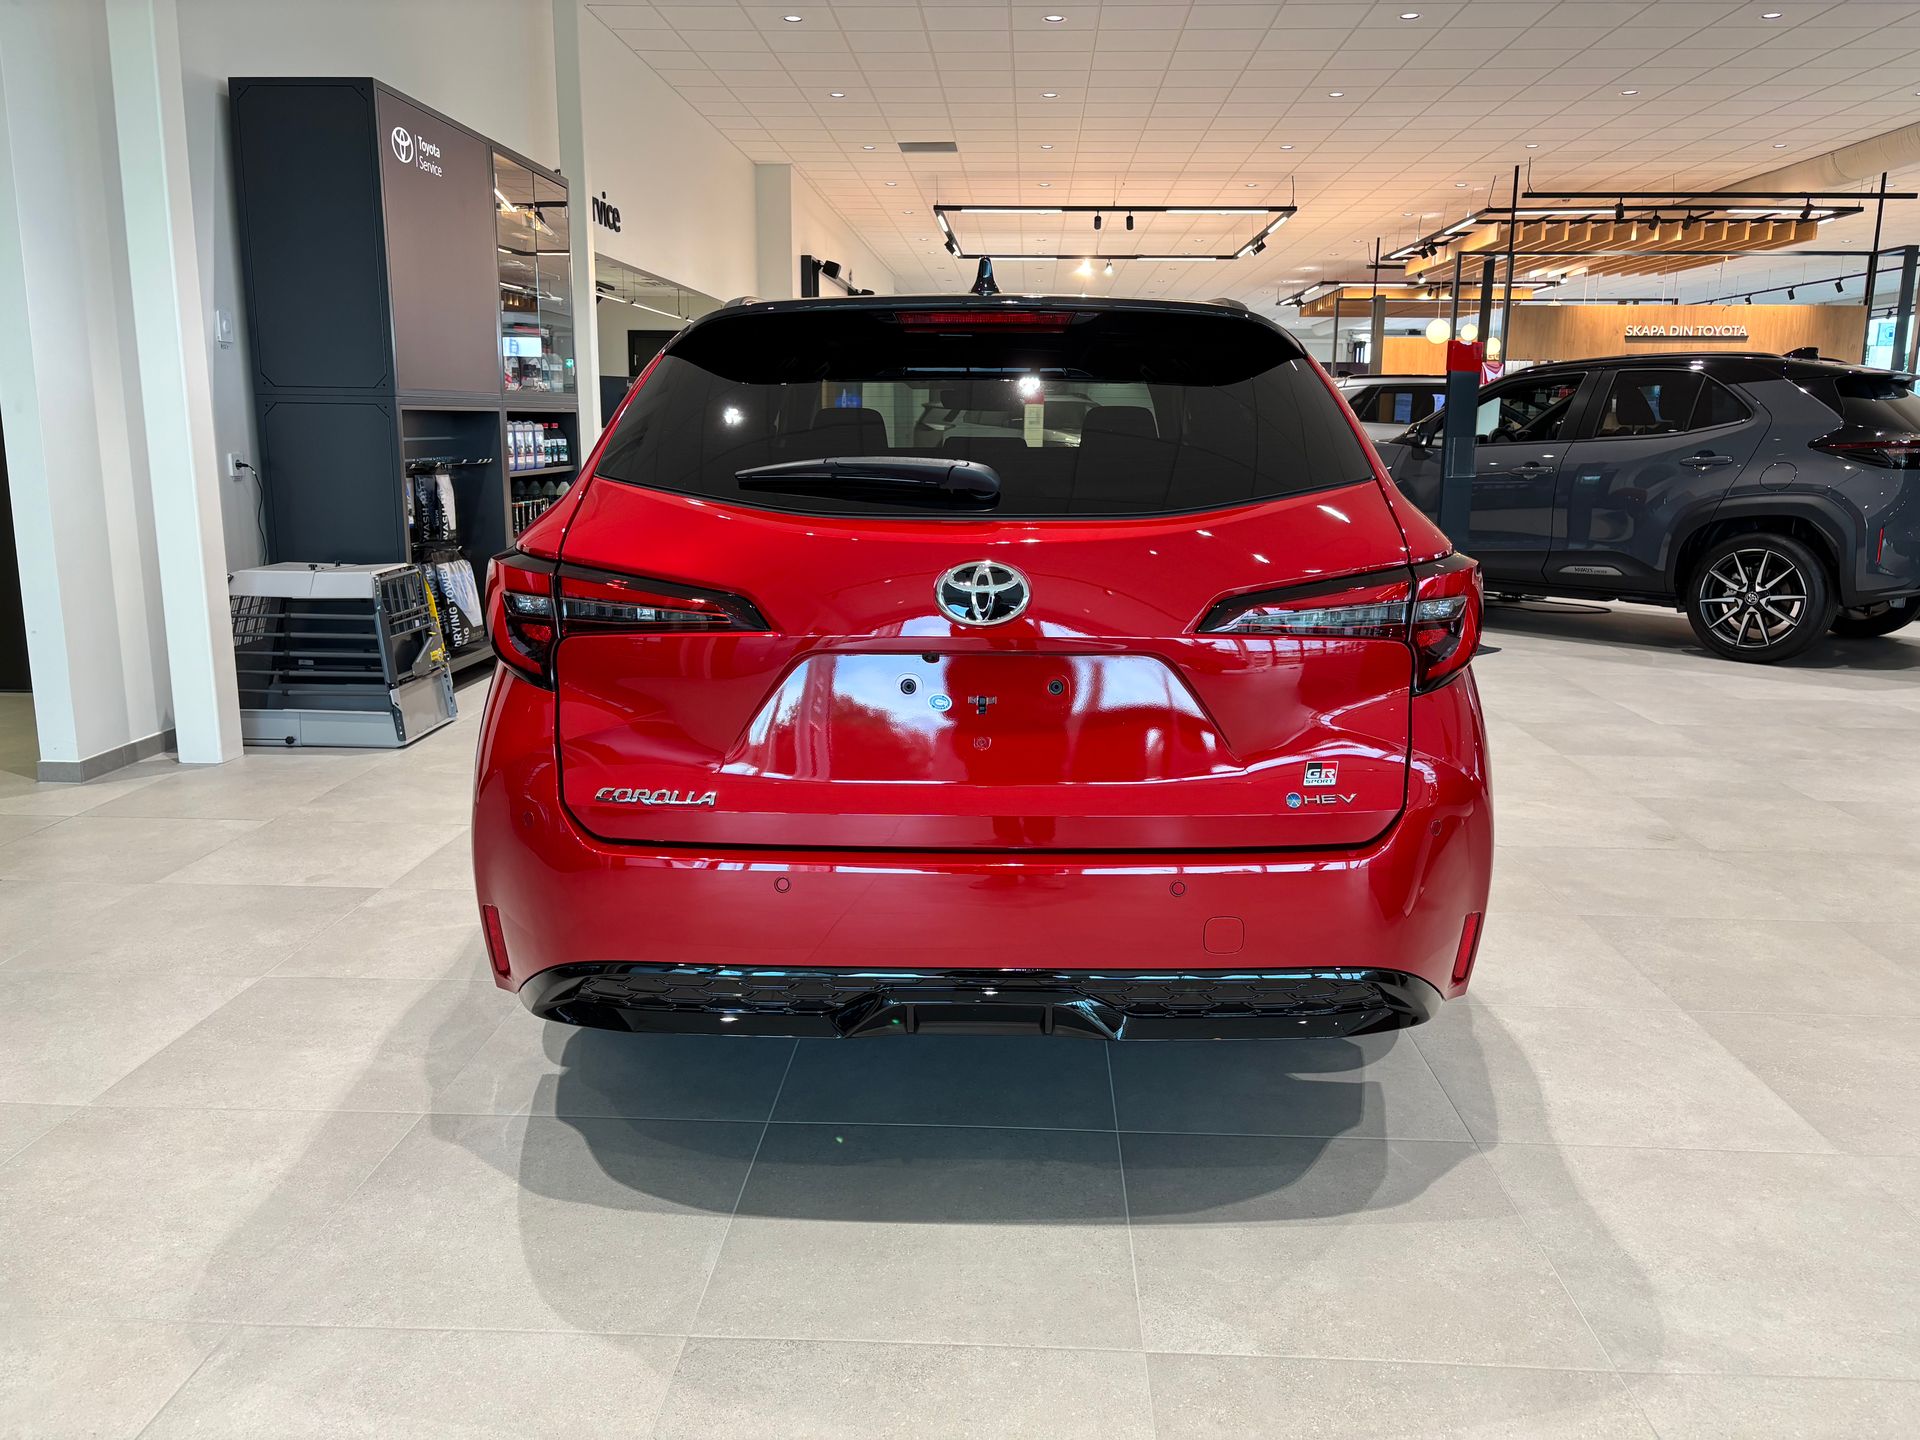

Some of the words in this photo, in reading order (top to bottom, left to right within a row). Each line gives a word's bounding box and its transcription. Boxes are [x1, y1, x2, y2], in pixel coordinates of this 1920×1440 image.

[417, 135, 441, 158] Toyota
[419, 156, 443, 177] Service
[1625, 325, 1666, 337] SKAPA
[1669, 325, 1693, 337] DIN
[1697, 325, 1748, 337] TOYOTA
[422, 507, 431, 542] WASH
[1306, 768, 1336, 779] GR
[595, 787, 718, 806] COROLLA
[1303, 793, 1358, 805] HEV
